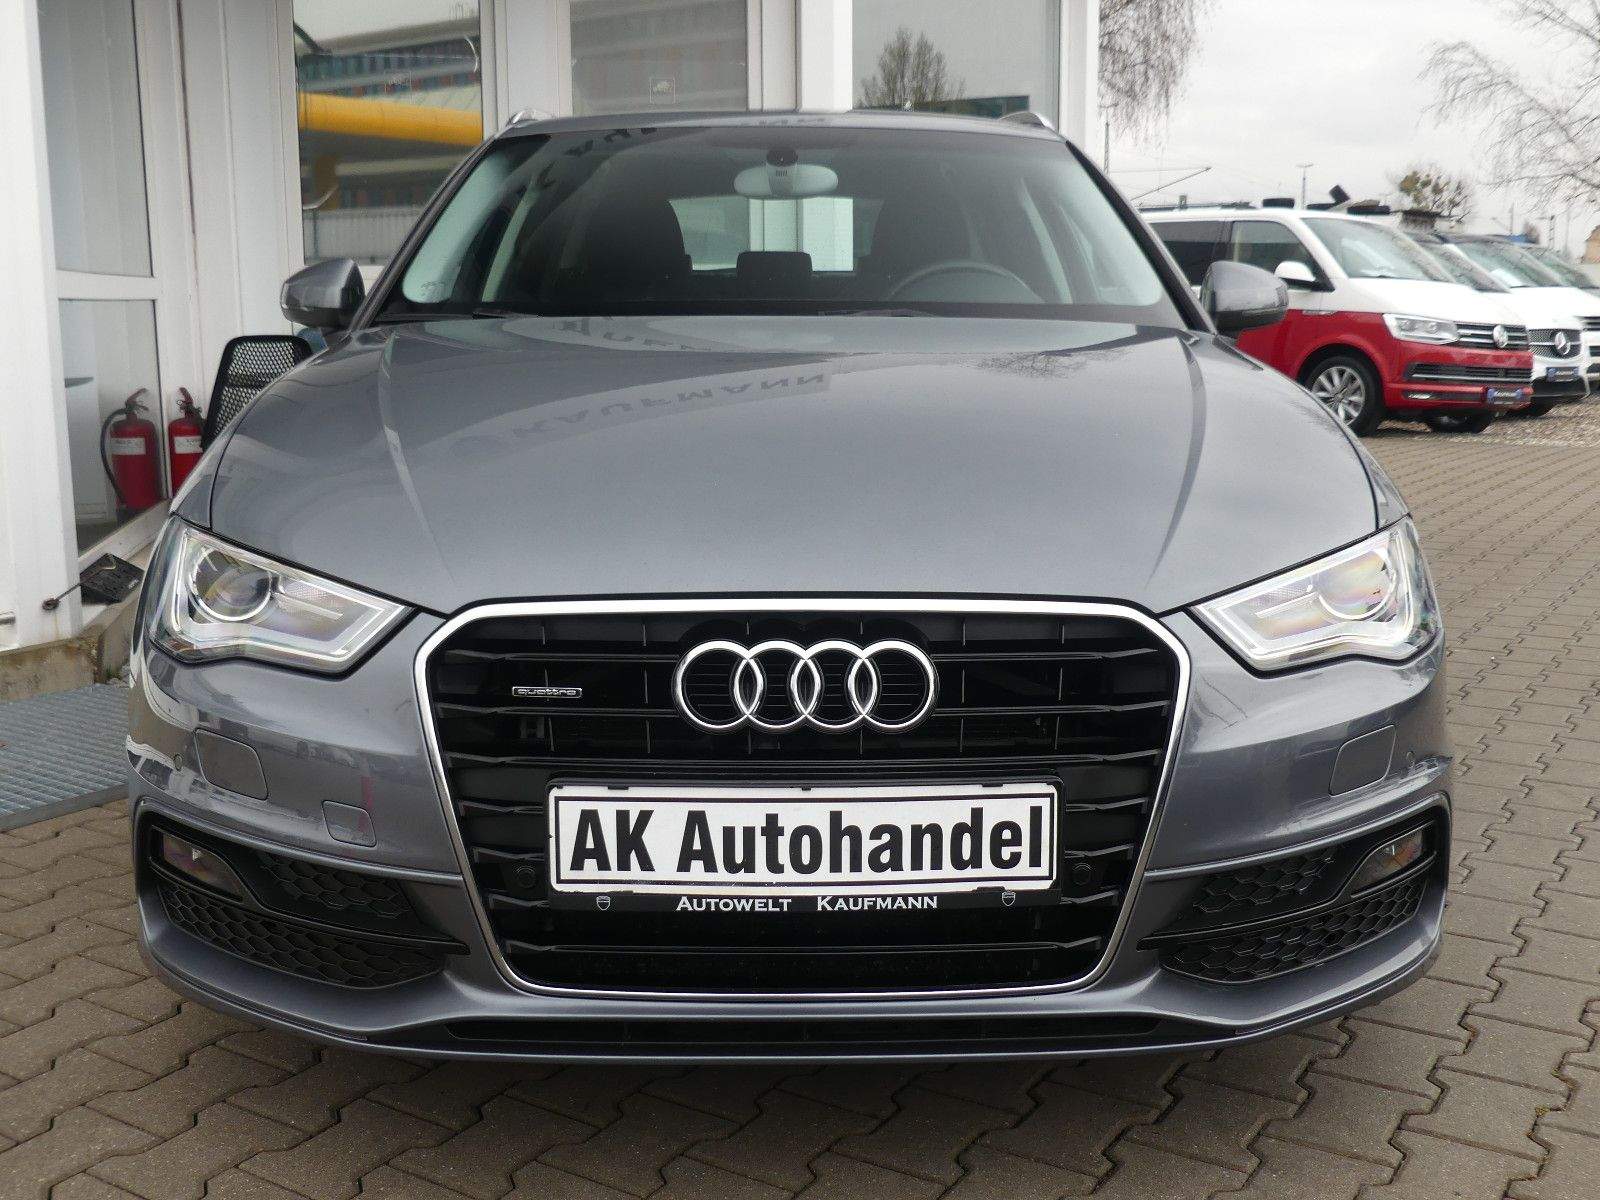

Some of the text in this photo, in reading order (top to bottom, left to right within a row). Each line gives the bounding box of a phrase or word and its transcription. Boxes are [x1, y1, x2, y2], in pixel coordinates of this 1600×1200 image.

[516, 688, 578, 697] quattro
[570, 805, 1043, 874] AK Autohandel
[675, 895, 938, 912] AUTOWELT KAUFMANN
